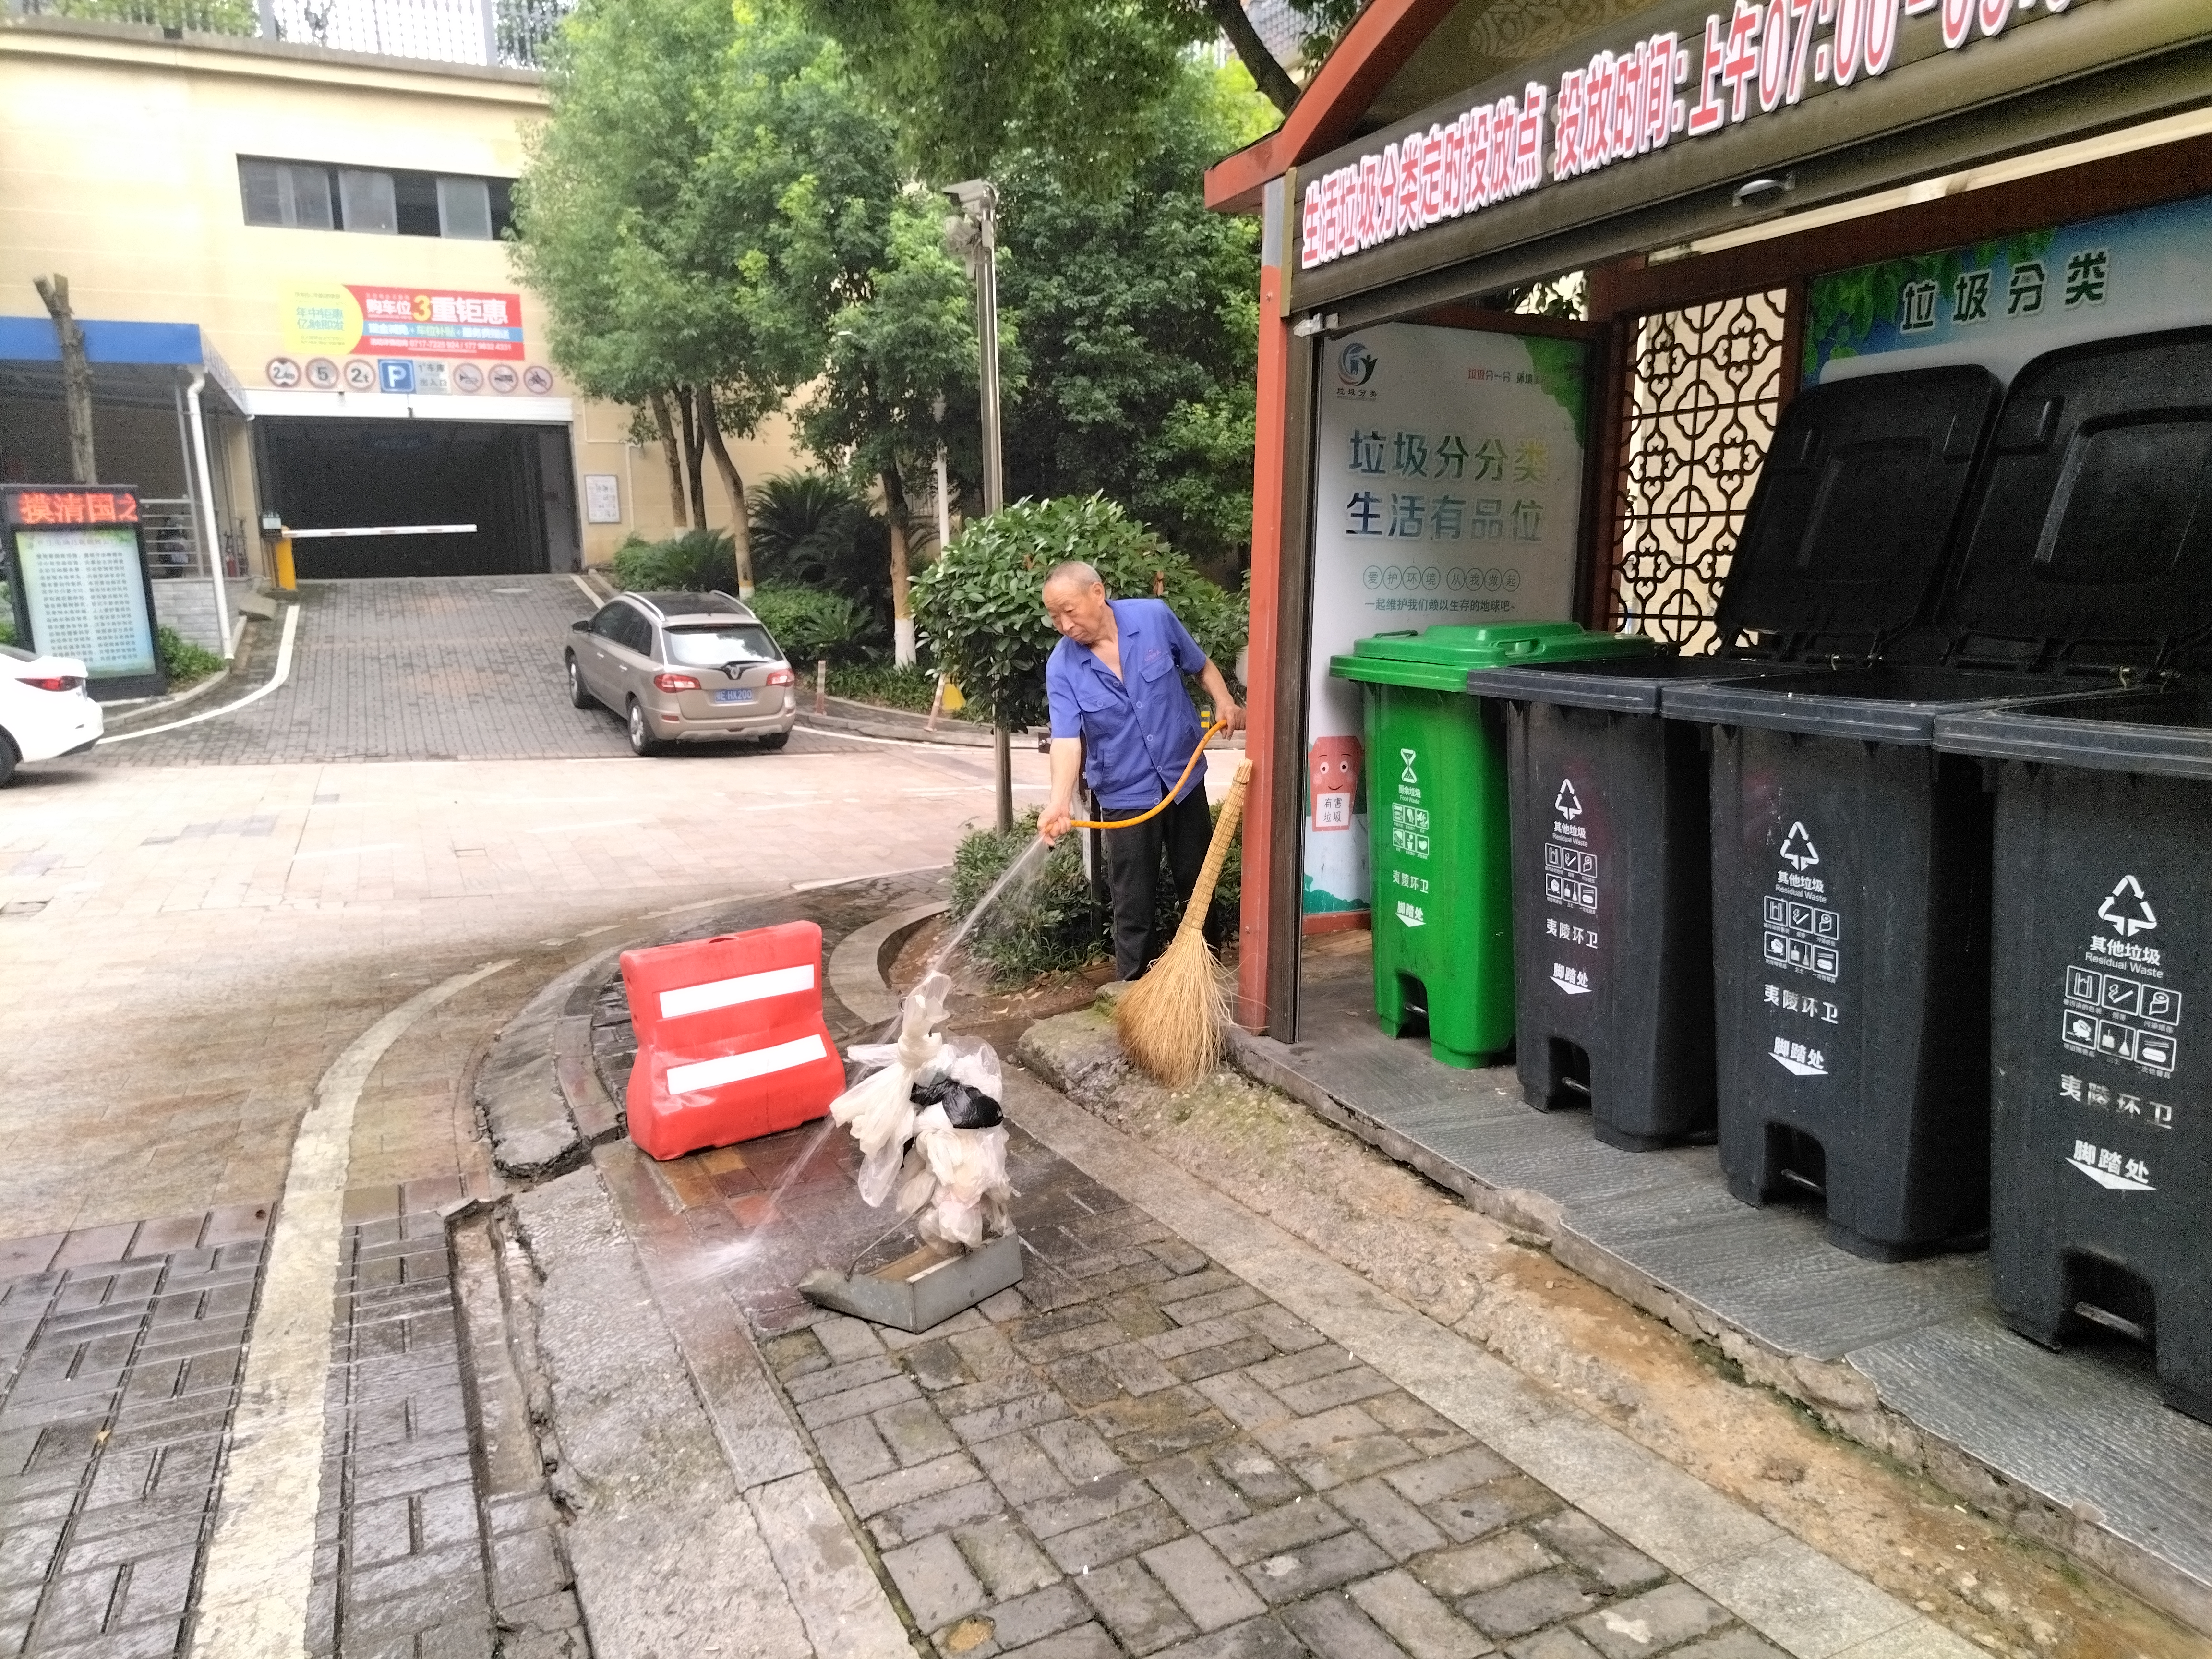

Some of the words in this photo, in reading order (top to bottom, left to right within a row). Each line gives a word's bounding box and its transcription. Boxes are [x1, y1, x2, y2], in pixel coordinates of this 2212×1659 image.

[1301, 82, 1546, 269] 生活垃圾分类定时投放点
[1901, 249, 2108, 333] 垃圾分类
[317, 366, 328, 381] 5
[351, 368, 369, 383] 2t
[388, 364, 406, 388] P
[419, 378, 447, 386] 出入口
[1467, 368, 1510, 383] 垃圾分一分
[1336, 387, 1378, 397] 垃圾分类
[1348, 429, 1547, 483] 垃圾分分类
[1346, 491, 1544, 541] 生活有品位
[1366, 570, 1438, 587] 爱护环境
[1449, 570, 1518, 587] 从我做起
[716, 690, 752, 701] E·HX200
[1323, 797, 1342, 809] 有害
[1323, 811, 1342, 823] 垃圾
[1552, 832, 1572, 843] Residual
[1572, 837, 1588, 847] Waste
[1553, 821, 1586, 839] 其他垃圾
[1392, 869, 1429, 894] 夷陵环卫
[1775, 883, 1803, 898] Residual
[1803, 890, 1827, 903] Waste
[1777, 870, 1824, 894] 其他垃圾
[1397, 900, 1423, 921] 脚踏处
[1546, 918, 1598, 949] 夷陵环卫
[2089, 935, 2160, 966] 其他垃圾
[1553, 962, 1588, 988] 脚踏处
[2085, 951, 2127, 970] Residual
[2129, 961, 2164, 979] Waste
[1764, 984, 1839, 1024] 夷陵环卫
[1774, 1036, 1824, 1070] 脚踏处
[2059, 1073, 2173, 1129] 夷陵环卫
[2073, 1139, 2149, 1184] 脚踏处
